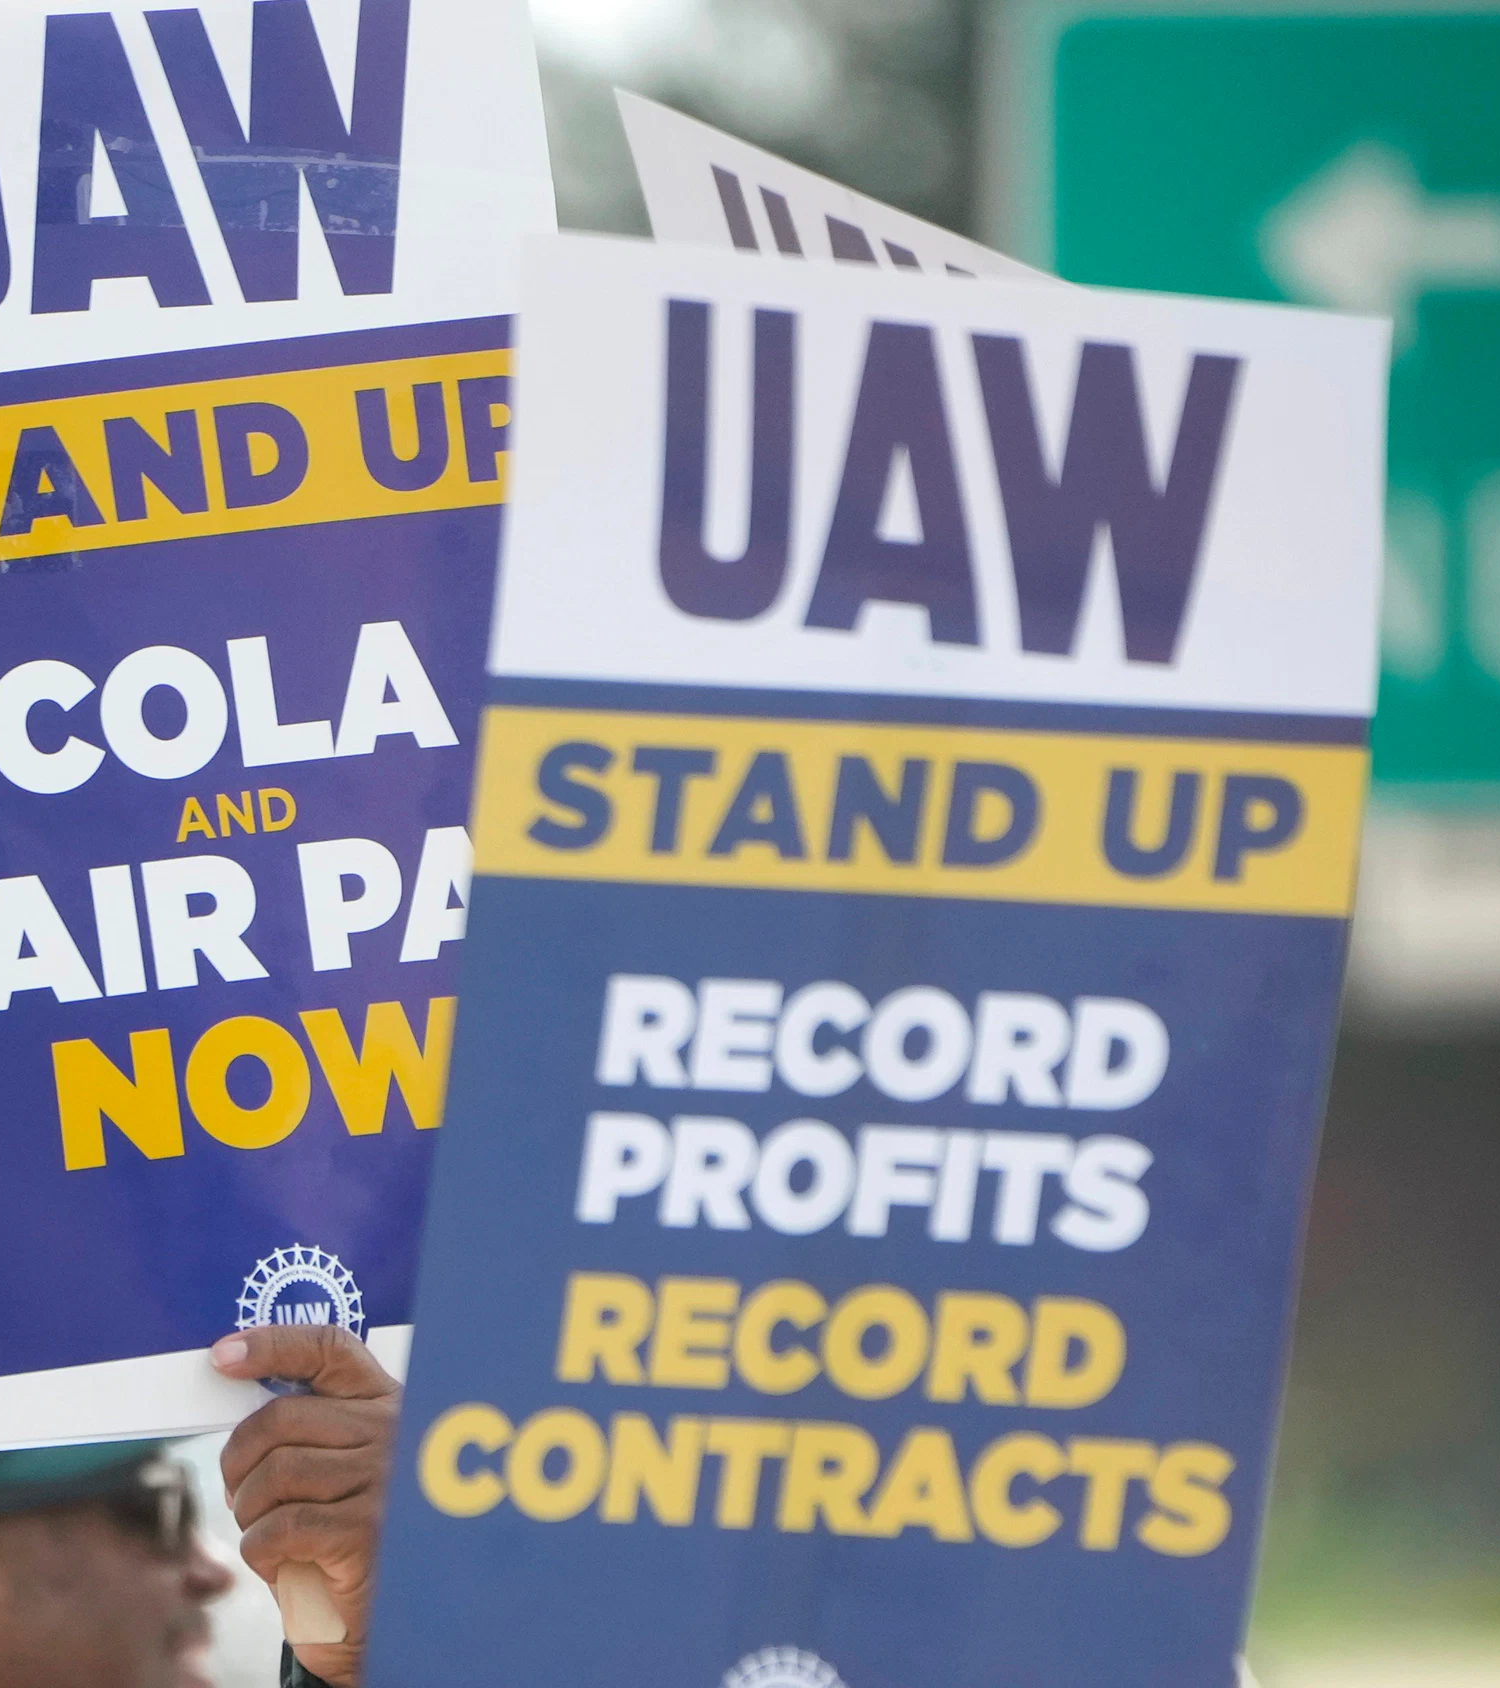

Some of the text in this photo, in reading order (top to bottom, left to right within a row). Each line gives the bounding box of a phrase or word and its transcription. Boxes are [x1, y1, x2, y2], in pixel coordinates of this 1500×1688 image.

[657, 297, 1245, 669] UAW
[176, 787, 298, 842] AND
[525, 740, 1306, 883] STAND UP
[298, 826, 474, 972] PA
[51, 997, 457, 1172] NOW
[597, 974, 1170, 1110] RECORD
[575, 1112, 1153, 1253] PROFITS
[276, 1302, 330, 1325] UAW
[556, 1272, 1127, 1409] RECORD
[417, 1404, 1235, 1558] CONTRACTS
